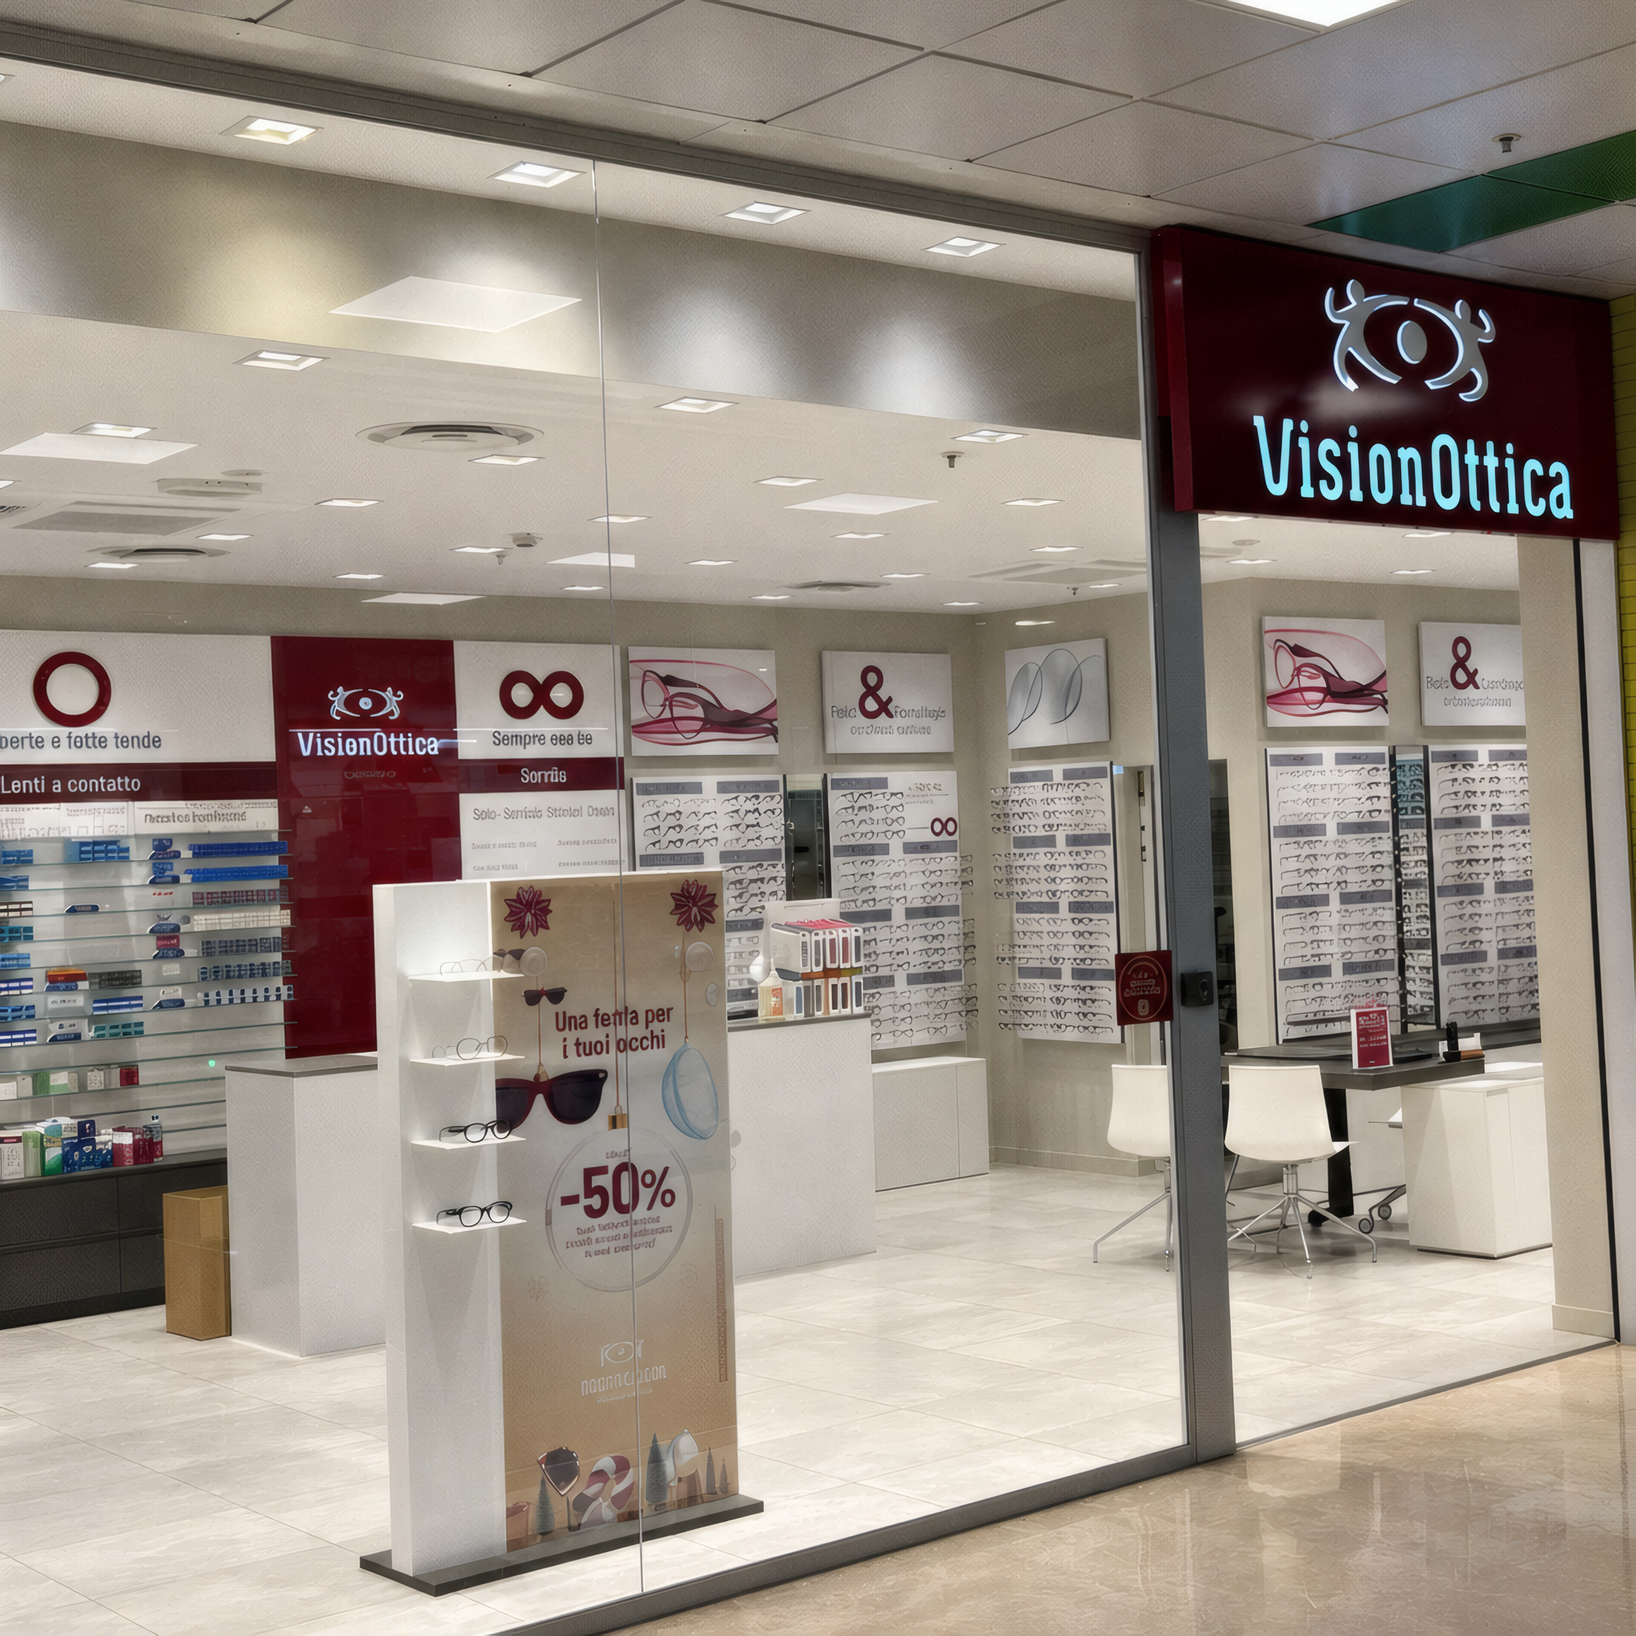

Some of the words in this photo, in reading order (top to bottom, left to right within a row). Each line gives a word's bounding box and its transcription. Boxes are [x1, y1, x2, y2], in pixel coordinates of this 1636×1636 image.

[1253, 414, 1574, 520] VisionOttica
[51, 735, 61, 749] e
[297, 731, 440, 757] VisionOttica
[492, 730, 546, 749] Sempre
[1, 775, 45, 794] Lenti
[52, 779, 62, 793] a
[67, 775, 141, 793] contatto
[555, 1010, 588, 1032] Una
[645, 1006, 674, 1030] per
[562, 1037, 569, 1059] i
[573, 1032, 610, 1058] tuoi
[616, 1028, 666, 1054] occhi
[560, 1161, 676, 1219] -50%
